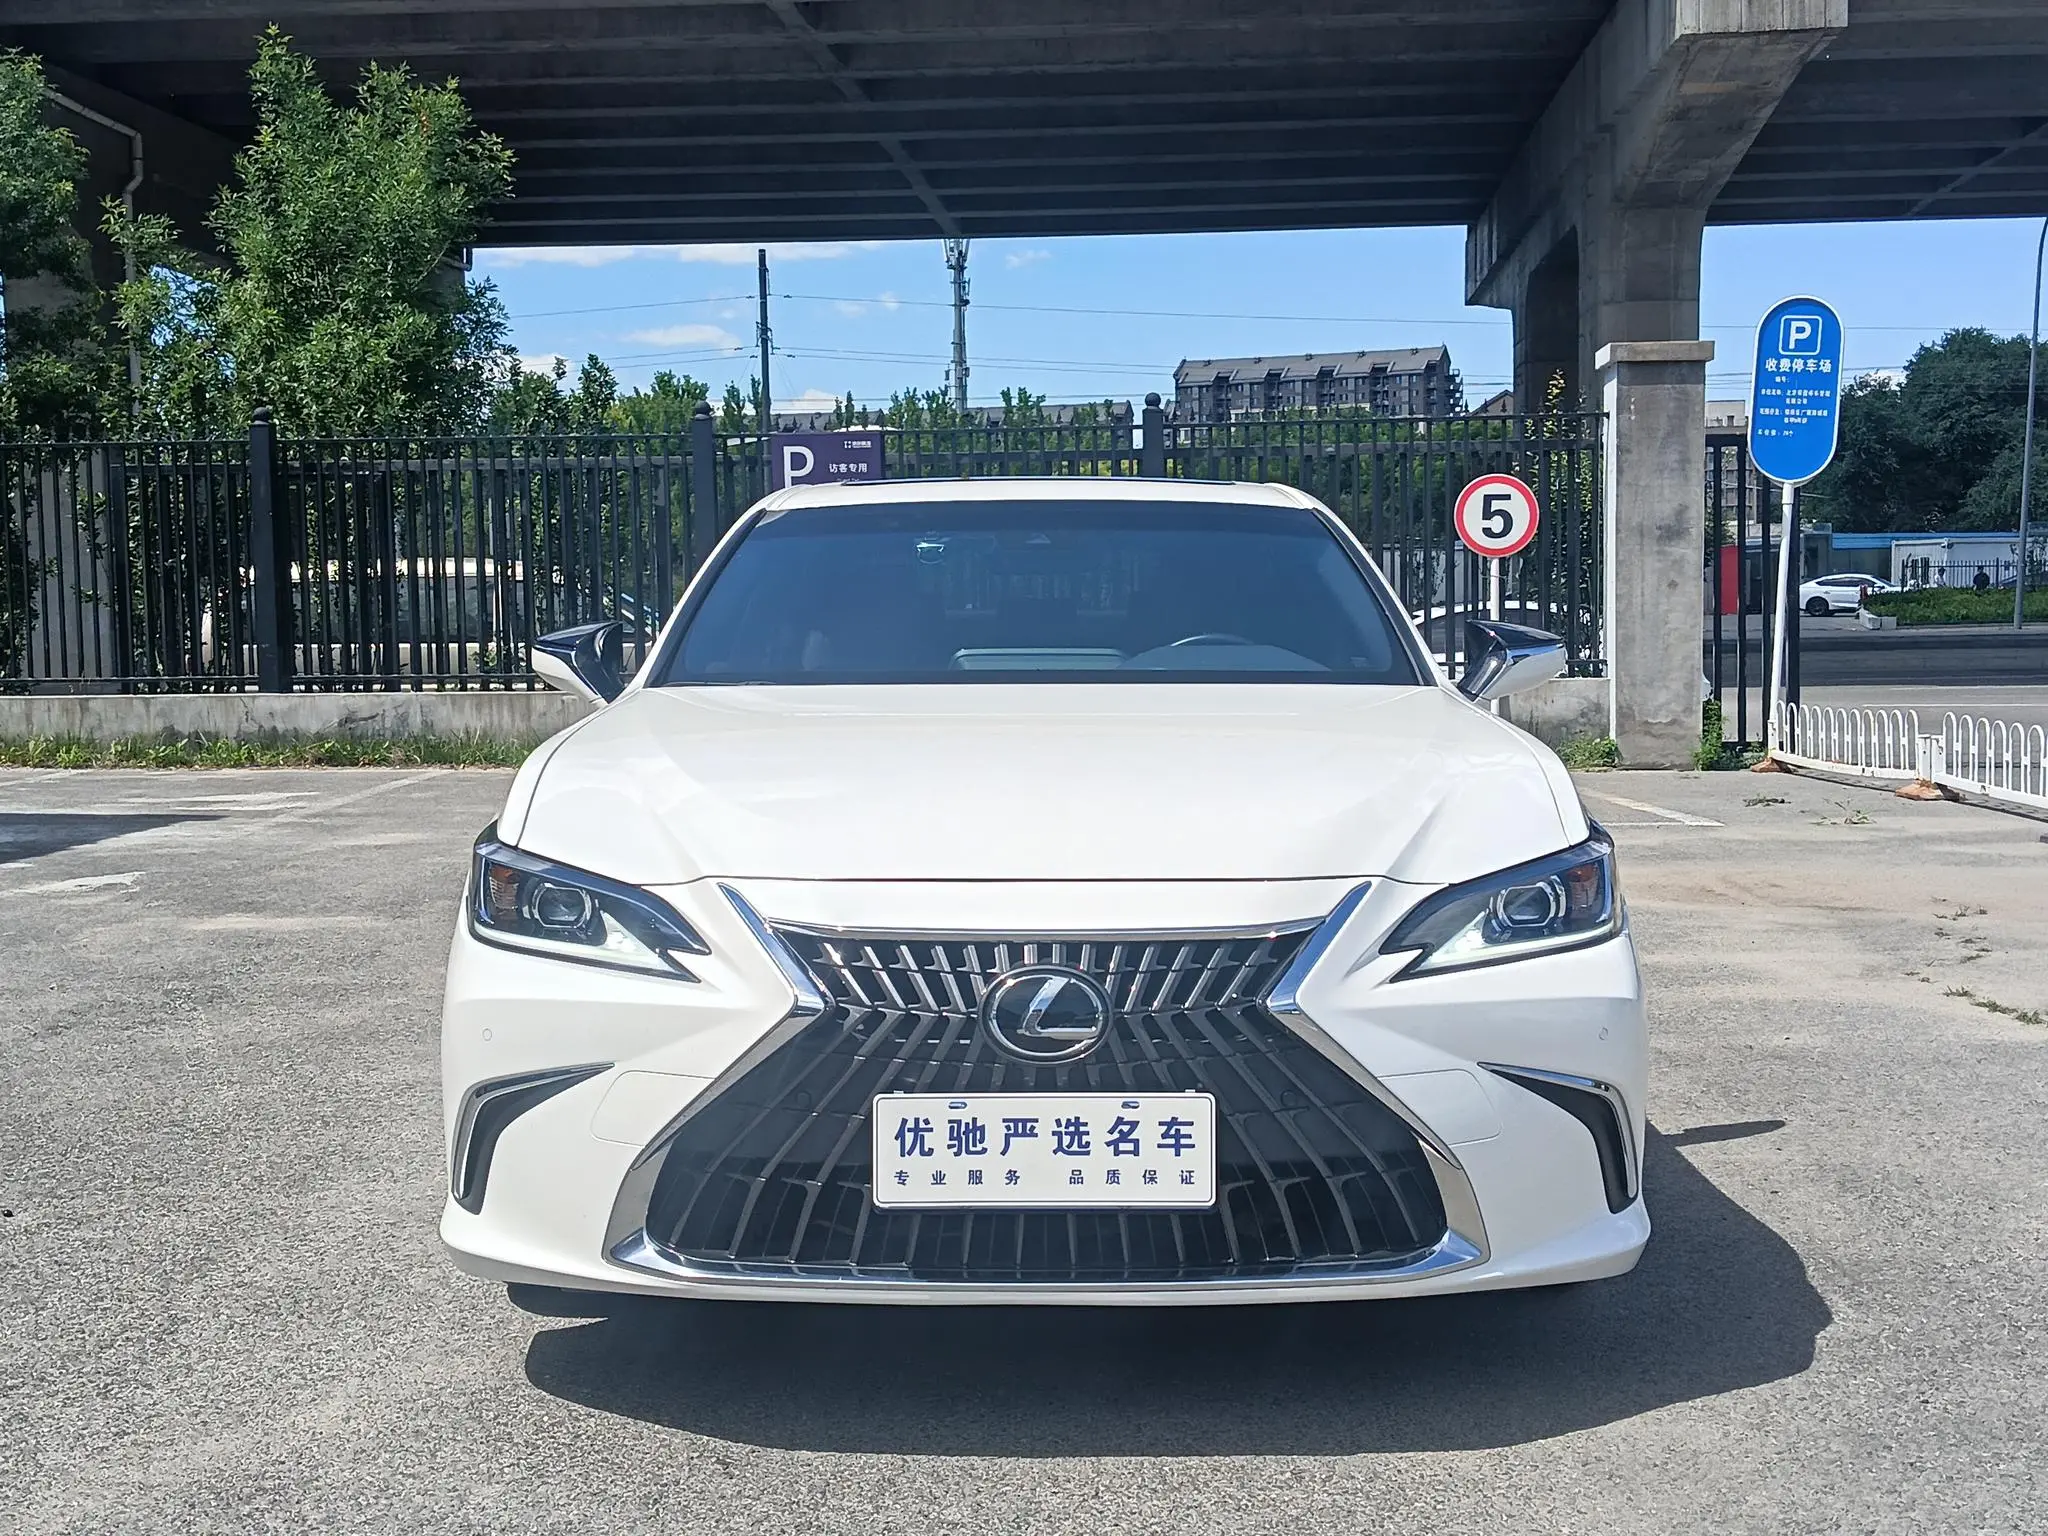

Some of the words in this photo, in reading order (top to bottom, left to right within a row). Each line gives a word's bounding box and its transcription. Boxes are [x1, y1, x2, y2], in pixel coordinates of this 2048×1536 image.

[1788, 321, 1812, 350] P
[1765, 358, 1832, 373] 收费停车场
[783, 445, 815, 489] P
[829, 463, 868, 473] 访客专用
[1481, 493, 1514, 539] 5
[894, 1116, 1196, 1157] 优驰严选名车
[894, 1169, 1021, 1186] 专业服务
[1069, 1169, 1196, 1185] 品质保证
